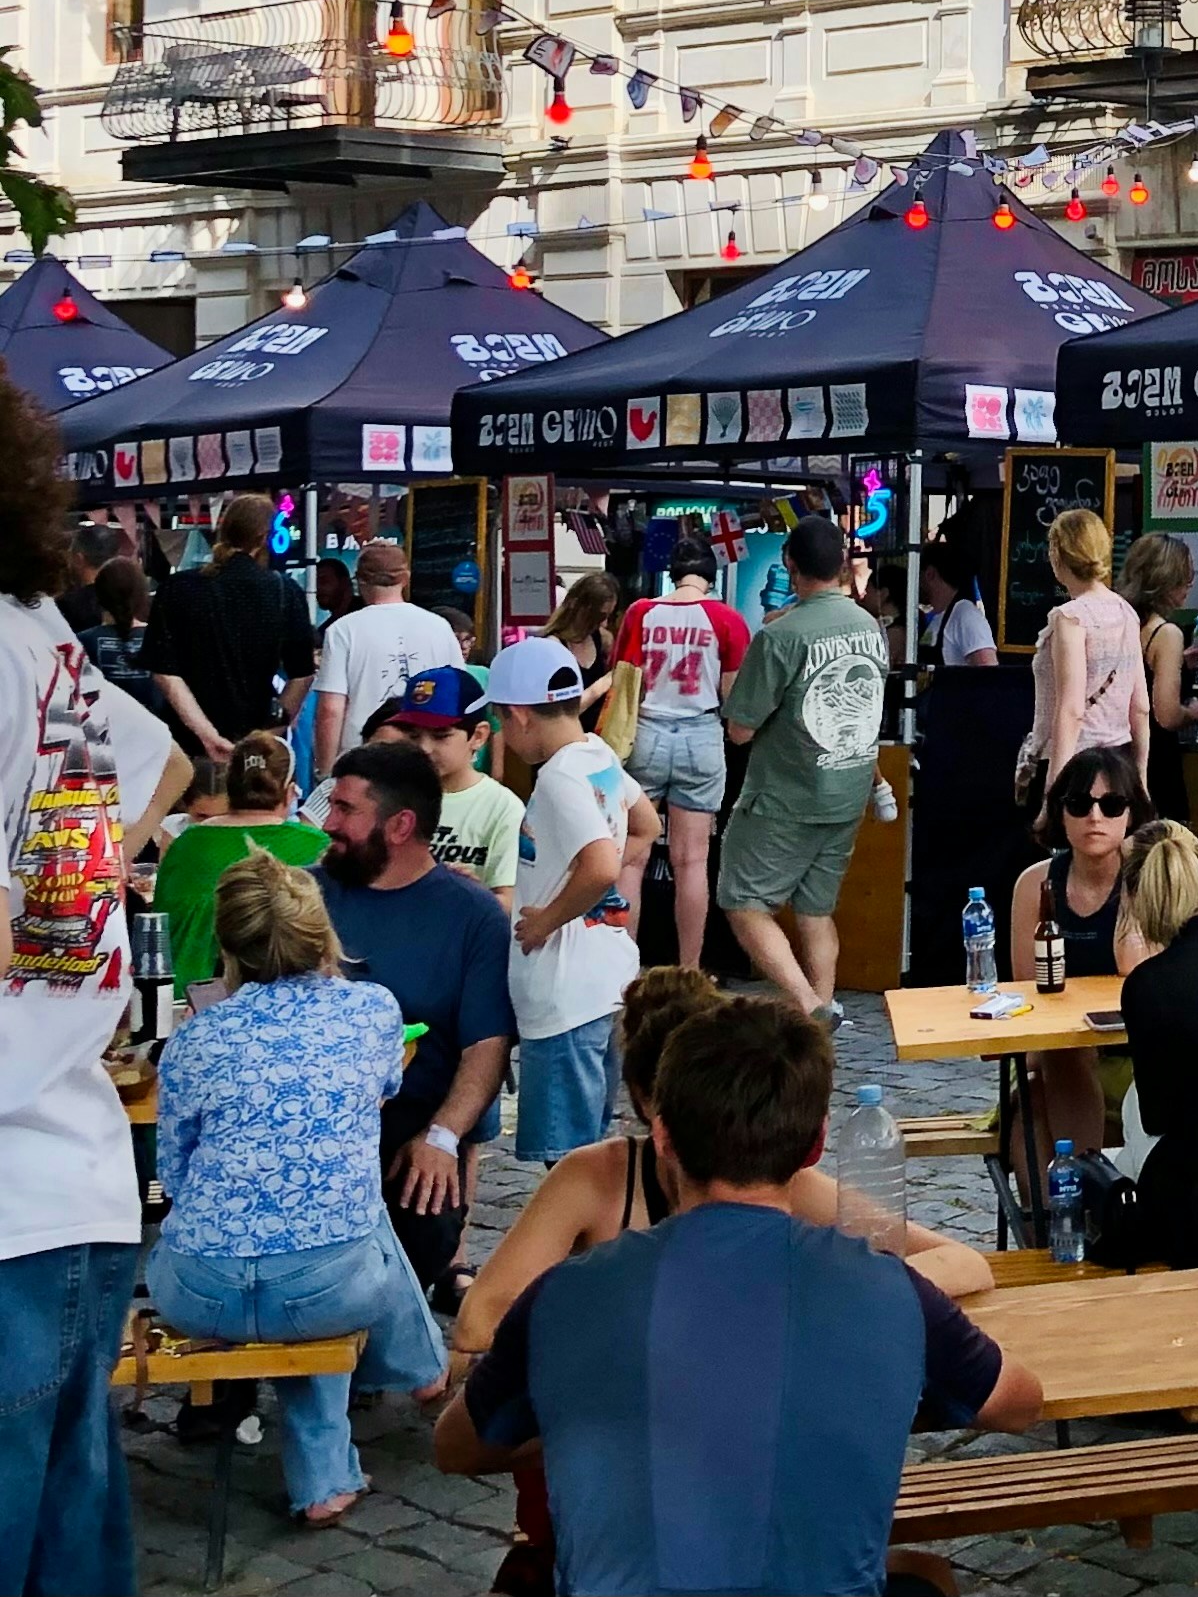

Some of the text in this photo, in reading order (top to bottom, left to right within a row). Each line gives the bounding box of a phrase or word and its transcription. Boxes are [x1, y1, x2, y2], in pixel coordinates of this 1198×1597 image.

[542, 406, 617, 444] GEMO
[272, 510, 290, 554] 6
[858, 489, 891, 537] 5
[644, 650, 703, 696] 74
